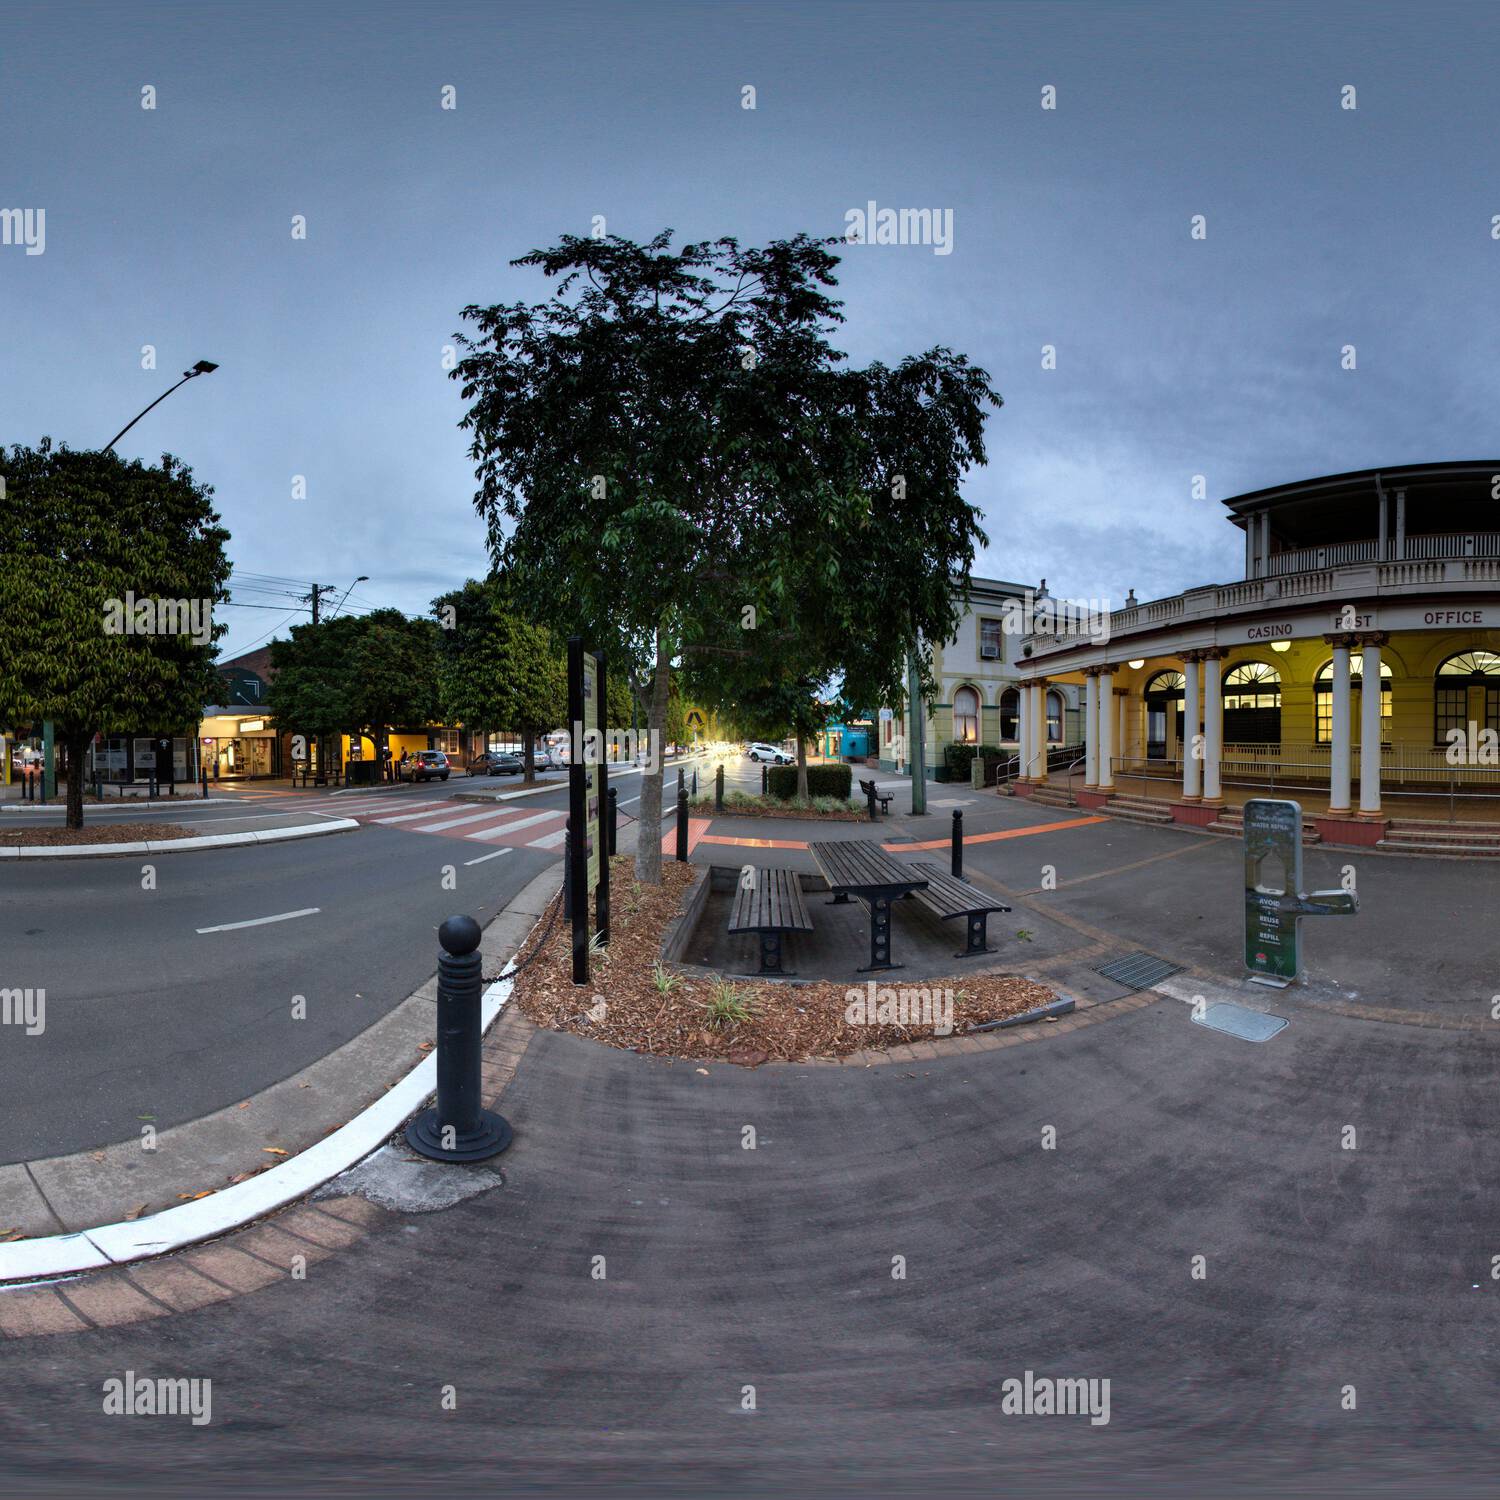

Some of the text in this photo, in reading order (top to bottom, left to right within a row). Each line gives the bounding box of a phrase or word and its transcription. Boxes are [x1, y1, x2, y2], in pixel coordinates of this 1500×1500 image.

[1247, 623, 1293, 639] CASINO
[1335, 615, 1372, 629] PST
[1424, 611, 1483, 625] OFFICE
[1259, 898, 1280, 907] AVOID
[1260, 915, 1279, 924] REUSE
[1259, 932, 1280, 941] REFILL
